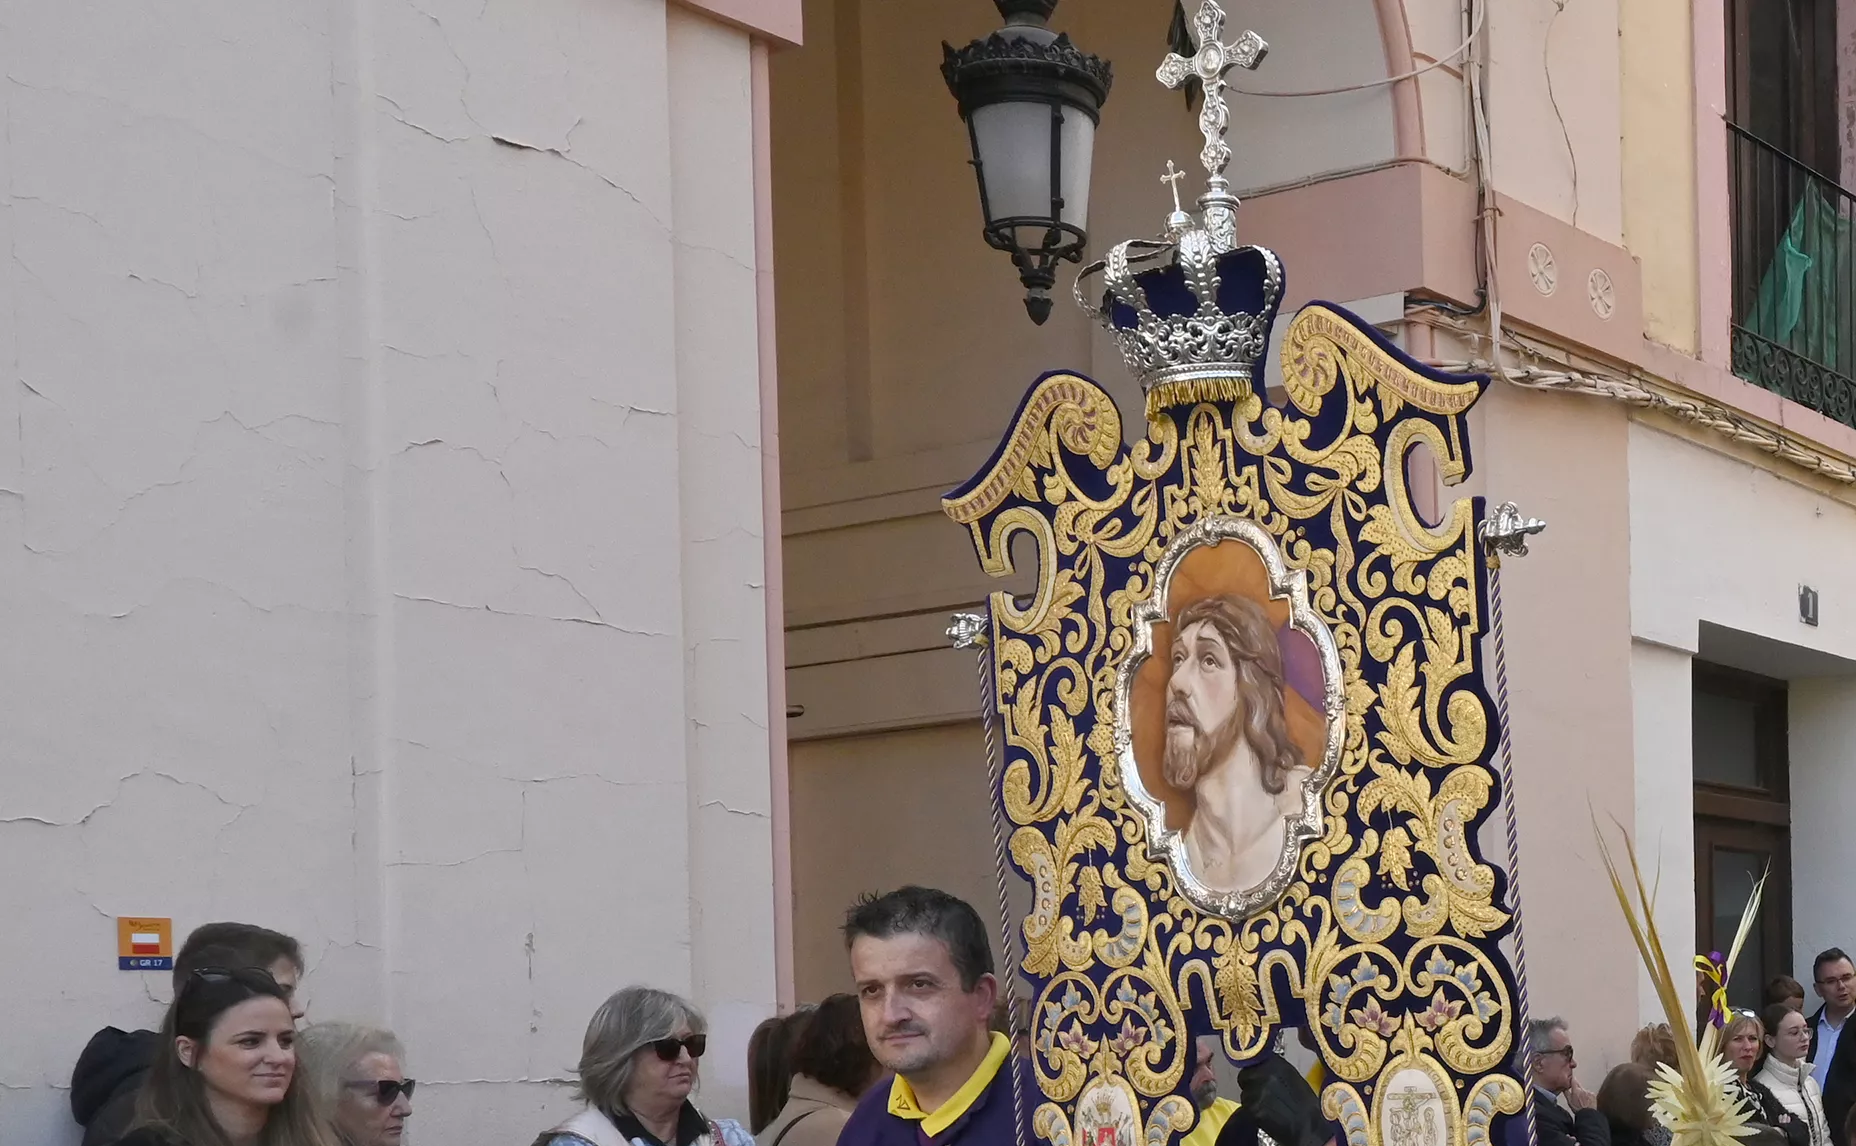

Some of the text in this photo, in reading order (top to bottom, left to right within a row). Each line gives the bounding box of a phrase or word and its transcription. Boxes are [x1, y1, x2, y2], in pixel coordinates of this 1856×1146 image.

[1807, 592, 1814, 619] 1
[139, 959, 163, 967] GR 17
